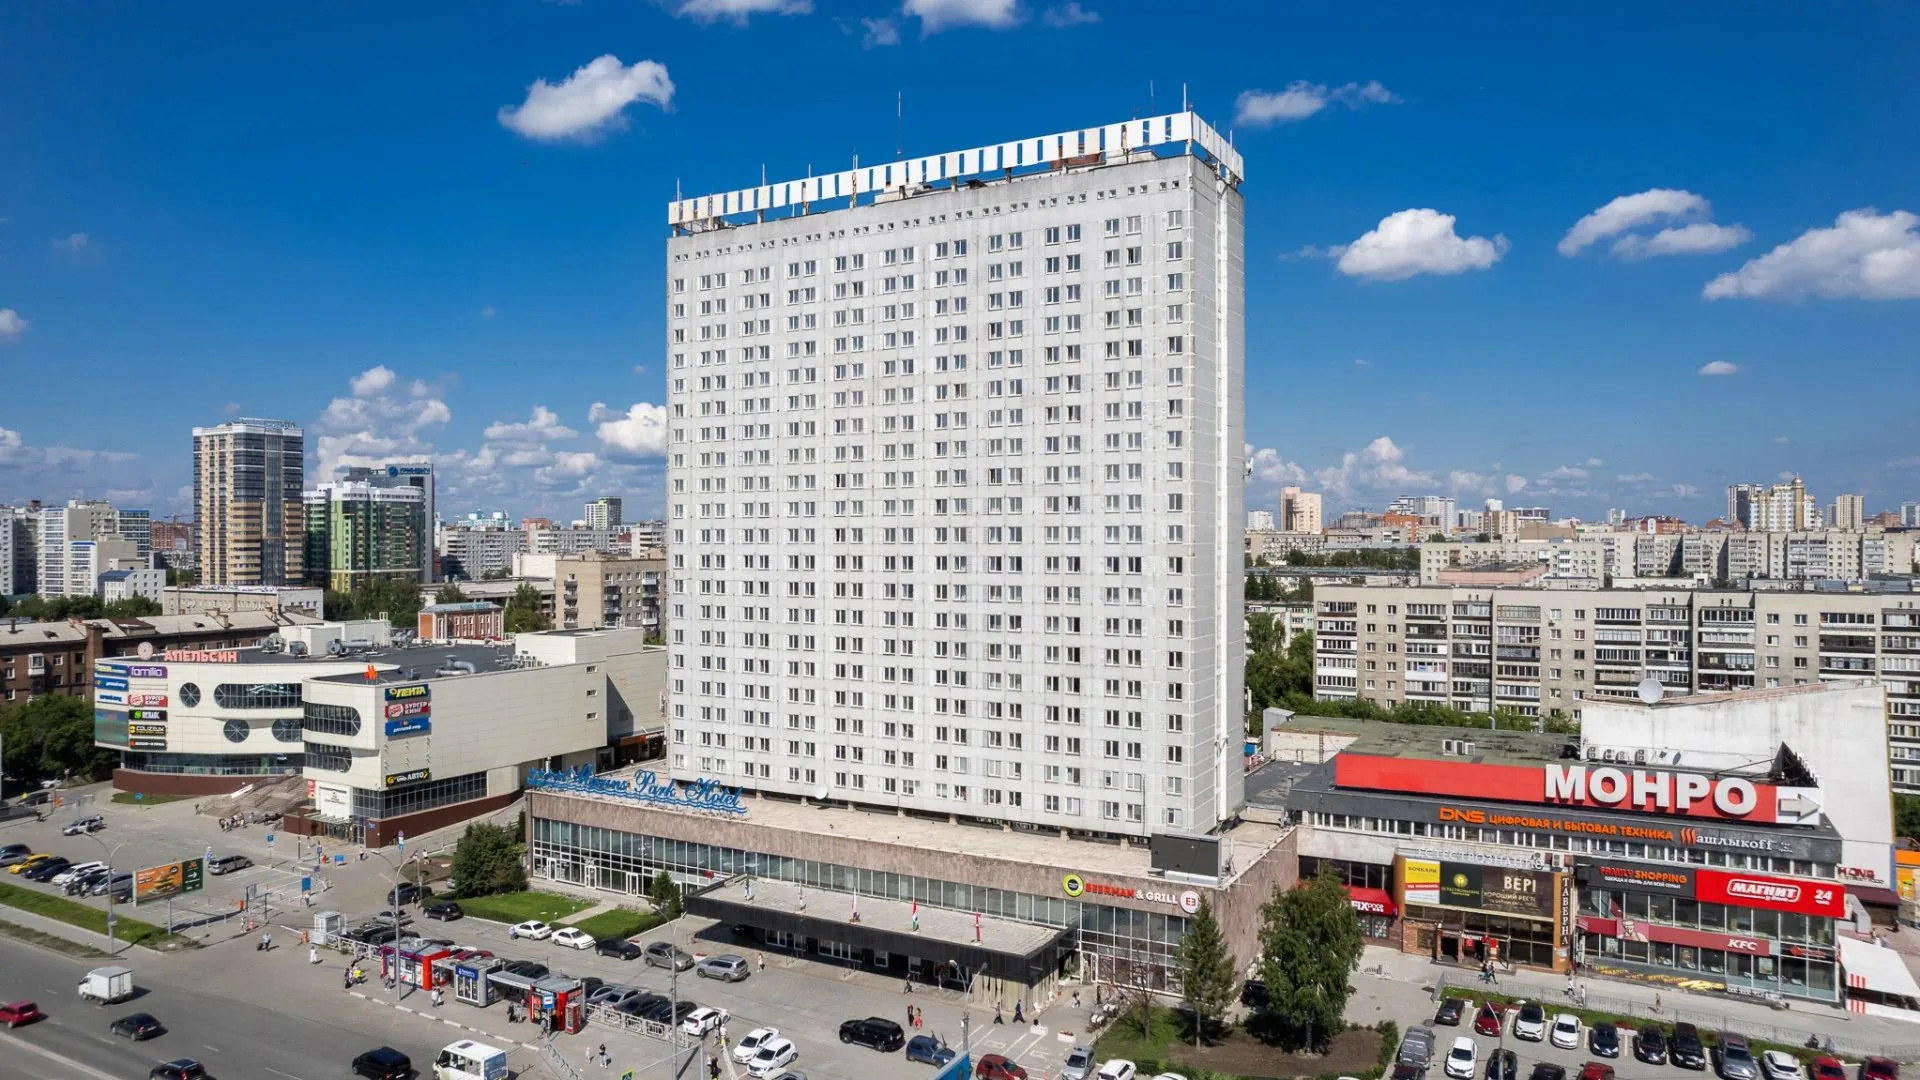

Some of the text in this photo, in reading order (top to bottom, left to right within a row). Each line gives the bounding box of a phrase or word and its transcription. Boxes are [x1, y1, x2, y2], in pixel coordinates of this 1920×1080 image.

[164, 649, 238, 663] АПЕЛЬСИН
[131, 666, 162, 677] familia
[396, 686, 426, 698] ЛЕНТА
[407, 771, 424, 781] АВТО
[633, 769, 677, 796] Park
[684, 778, 744, 808] Hotel
[1545, 764, 1758, 815] МОНРО
[1439, 807, 1674, 840] DNS ЦИФРОВАЯ И БЫТОВАЯ ТЕХНИКА
[1634, 870, 1688, 884] SHOPPING
[1085, 883, 1135, 898] BEERMAN
[1136, 889, 1144, 900] &
[1145, 891, 1178, 904] GRILL
[1484, 890, 1518, 899] ХОРОШИЙ
[1732, 882, 1797, 898] МАГНИТ
[1814, 889, 1833, 900] 24
[1562, 877, 1570, 945] ТАВЕРНА
[1727, 939, 1757, 951] KFC
